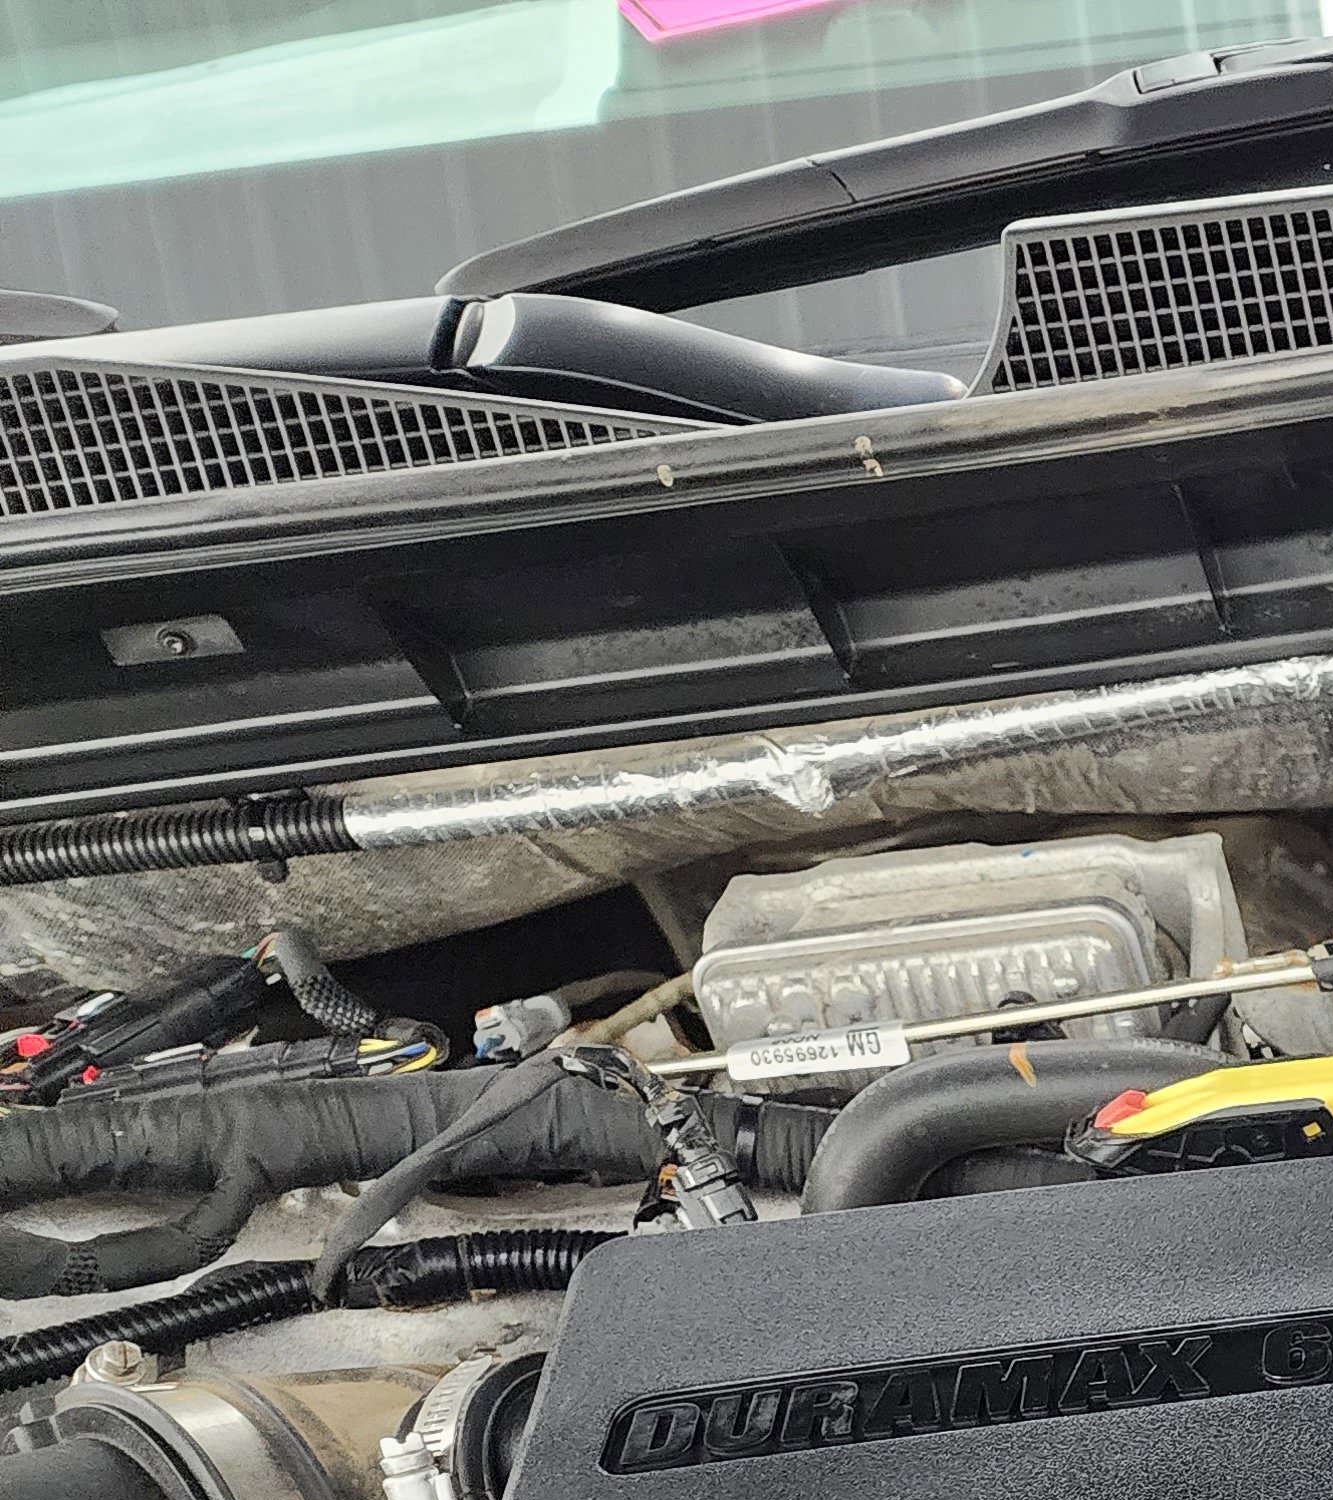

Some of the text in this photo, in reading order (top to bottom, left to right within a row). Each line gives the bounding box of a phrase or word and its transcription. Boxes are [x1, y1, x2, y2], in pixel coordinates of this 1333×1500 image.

[750, 1044, 838, 1067] 12695930
[845, 1031, 881, 1057] GM
[616, 1333, 1216, 1468] DURAMAX
